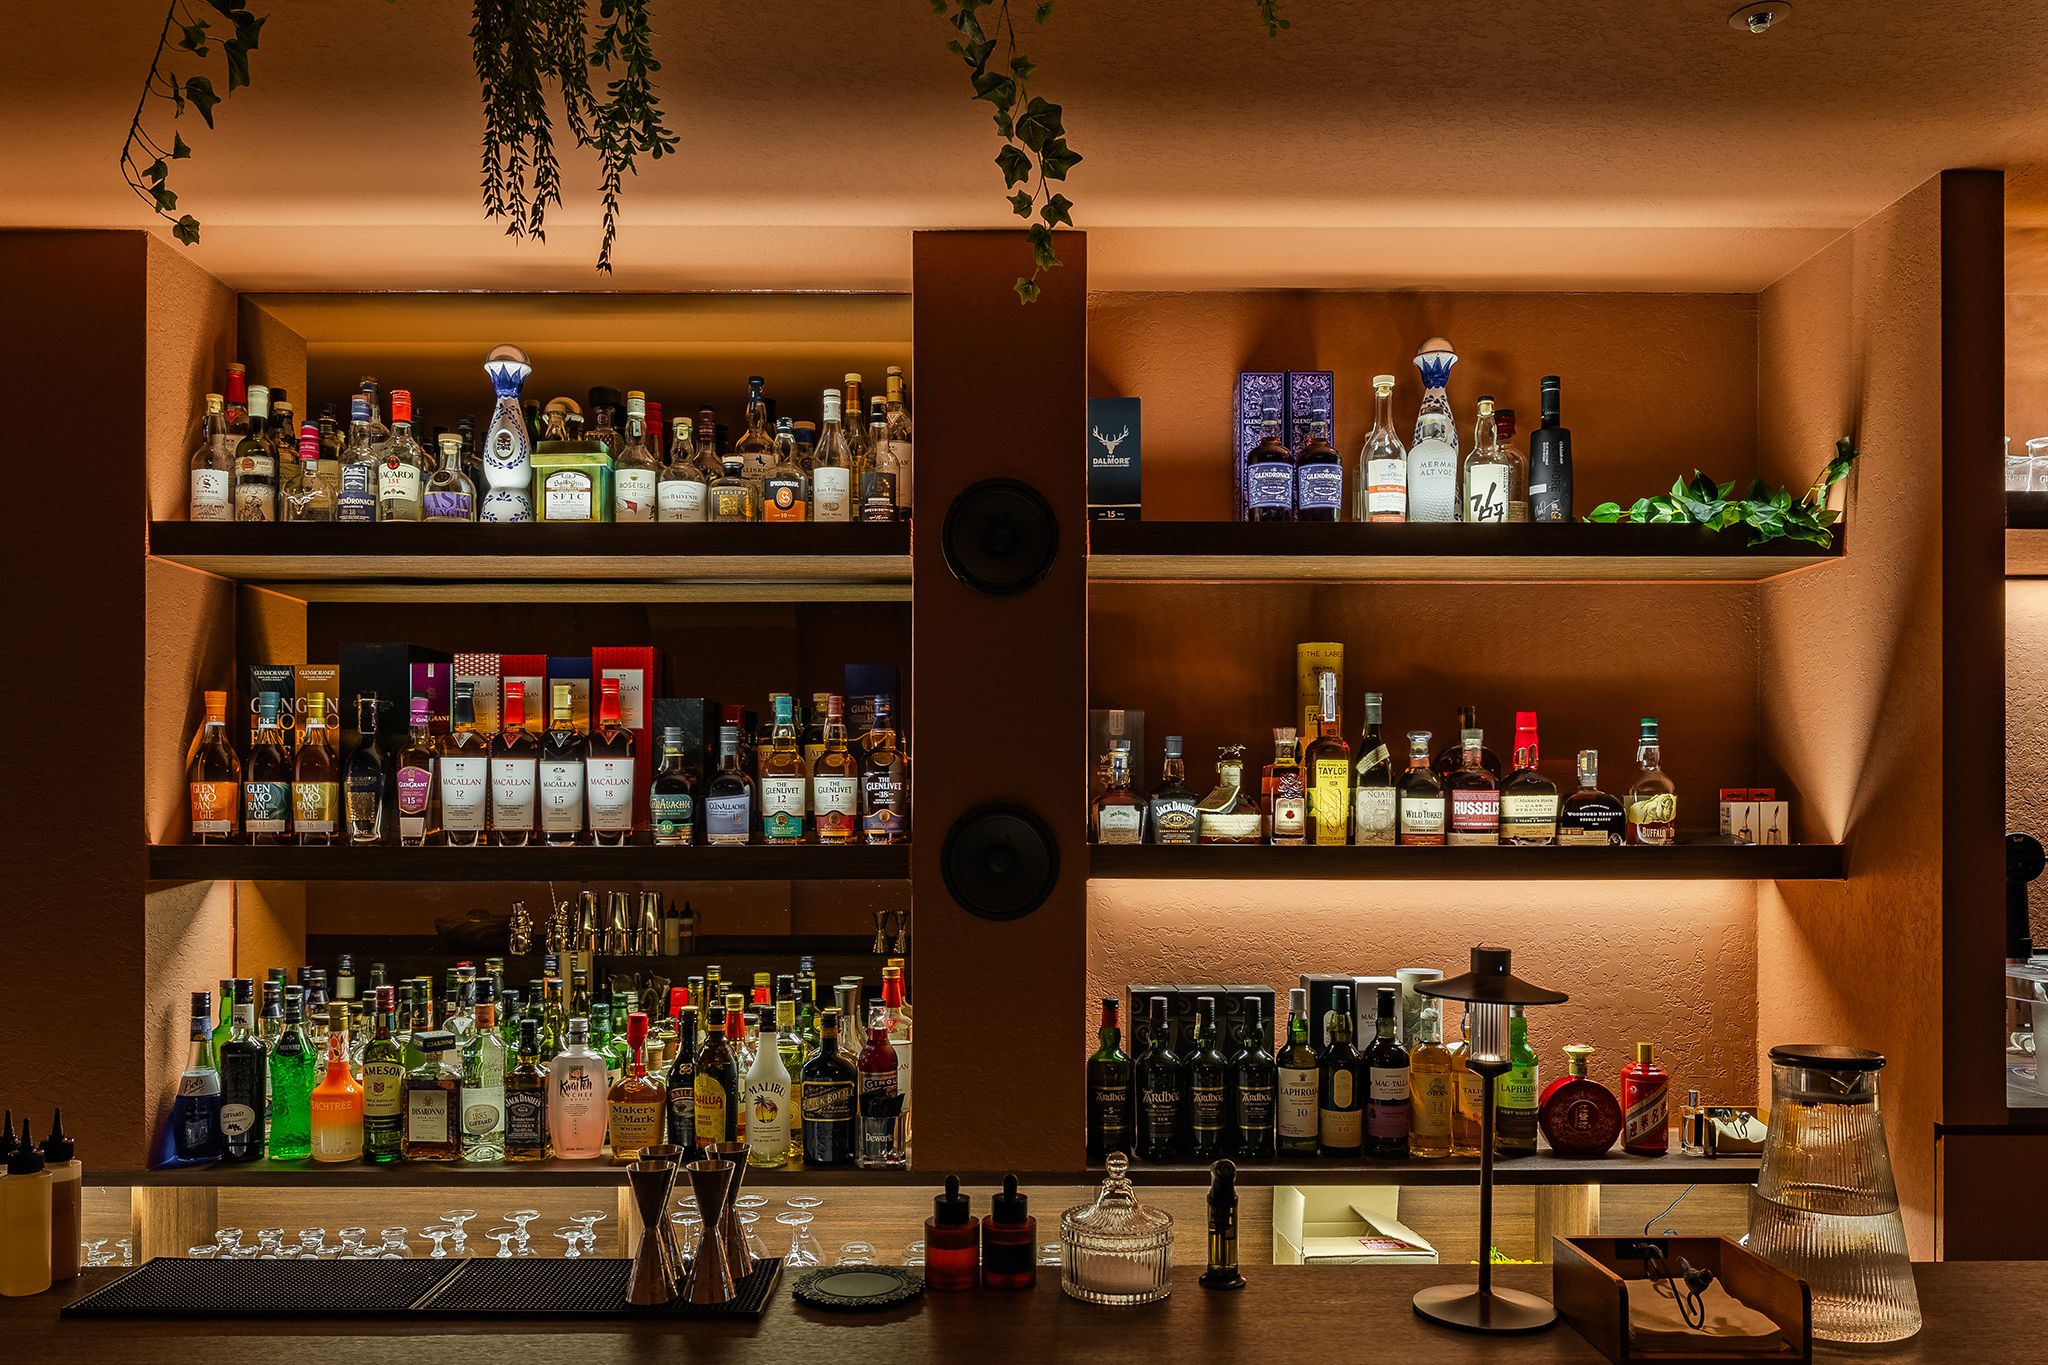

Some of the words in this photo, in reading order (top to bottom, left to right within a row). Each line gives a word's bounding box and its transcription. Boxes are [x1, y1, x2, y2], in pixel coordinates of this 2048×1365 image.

[1093, 457, 1129, 465] DALMORE
[380, 471, 414, 479] BACARDI
[619, 482, 650, 490] ROSEISLE
[428, 493, 470, 508] ASK
[851, 705, 874, 713] GLENL
[1318, 767, 1347, 775] TAYLOR
[398, 780, 428, 788] GLENGRANT
[442, 778, 481, 786] MACALLAN
[493, 778, 531, 786] MACALLAN
[866, 782, 902, 791] GLENLIVET
[193, 784, 216, 793] GLEN
[248, 784, 270, 793] GLEN
[296, 784, 318, 793] GLEN
[765, 787, 799, 795] GLENLIVET
[818, 786, 852, 794] GLENLIVET
[199, 793, 216, 802] MO
[254, 793, 271, 802] MO
[302, 793, 320, 802] MO
[455, 790, 464, 798] 12
[831, 794, 840, 802] 15
[554, 796, 564, 804] 15
[777, 795, 786, 803] 12
[194, 802, 211, 811] RAN
[248, 802, 266, 811] RAN
[296, 802, 314, 811] RAN
[709, 801, 746, 810] GLENALLACHIE
[1155, 802, 1172, 817] JACK
[199, 810, 214, 819] GIE
[254, 810, 269, 819] GIE
[302, 810, 318, 819] GIE
[1406, 810, 1422, 819] WILD
[1423, 810, 1442, 819] TURKEY
[1642, 827, 1667, 837] BUFFALO
[748, 1082, 786, 1098] MALIBU
[1280, 1087, 1319, 1097] LAPHROA
[1501, 1084, 1535, 1093] LAPHRO
[1142, 1088, 1180, 1103] Ardbeg
[1193, 1091, 1224, 1103] Ardbeg
[1241, 1091, 1272, 1103] Ardbeg
[312, 1101, 352, 1110] EACHTREE
[505, 1095, 519, 1107] JACK
[412, 1108, 445, 1116] DISARONNO
[612, 1105, 656, 1113] Maker's
[1296, 1109, 1308, 1117] 10
[223, 1111, 244, 1119] GIFFARD
[624, 1115, 655, 1123] Mark
[469, 1118, 493, 1127] GIFFARD
